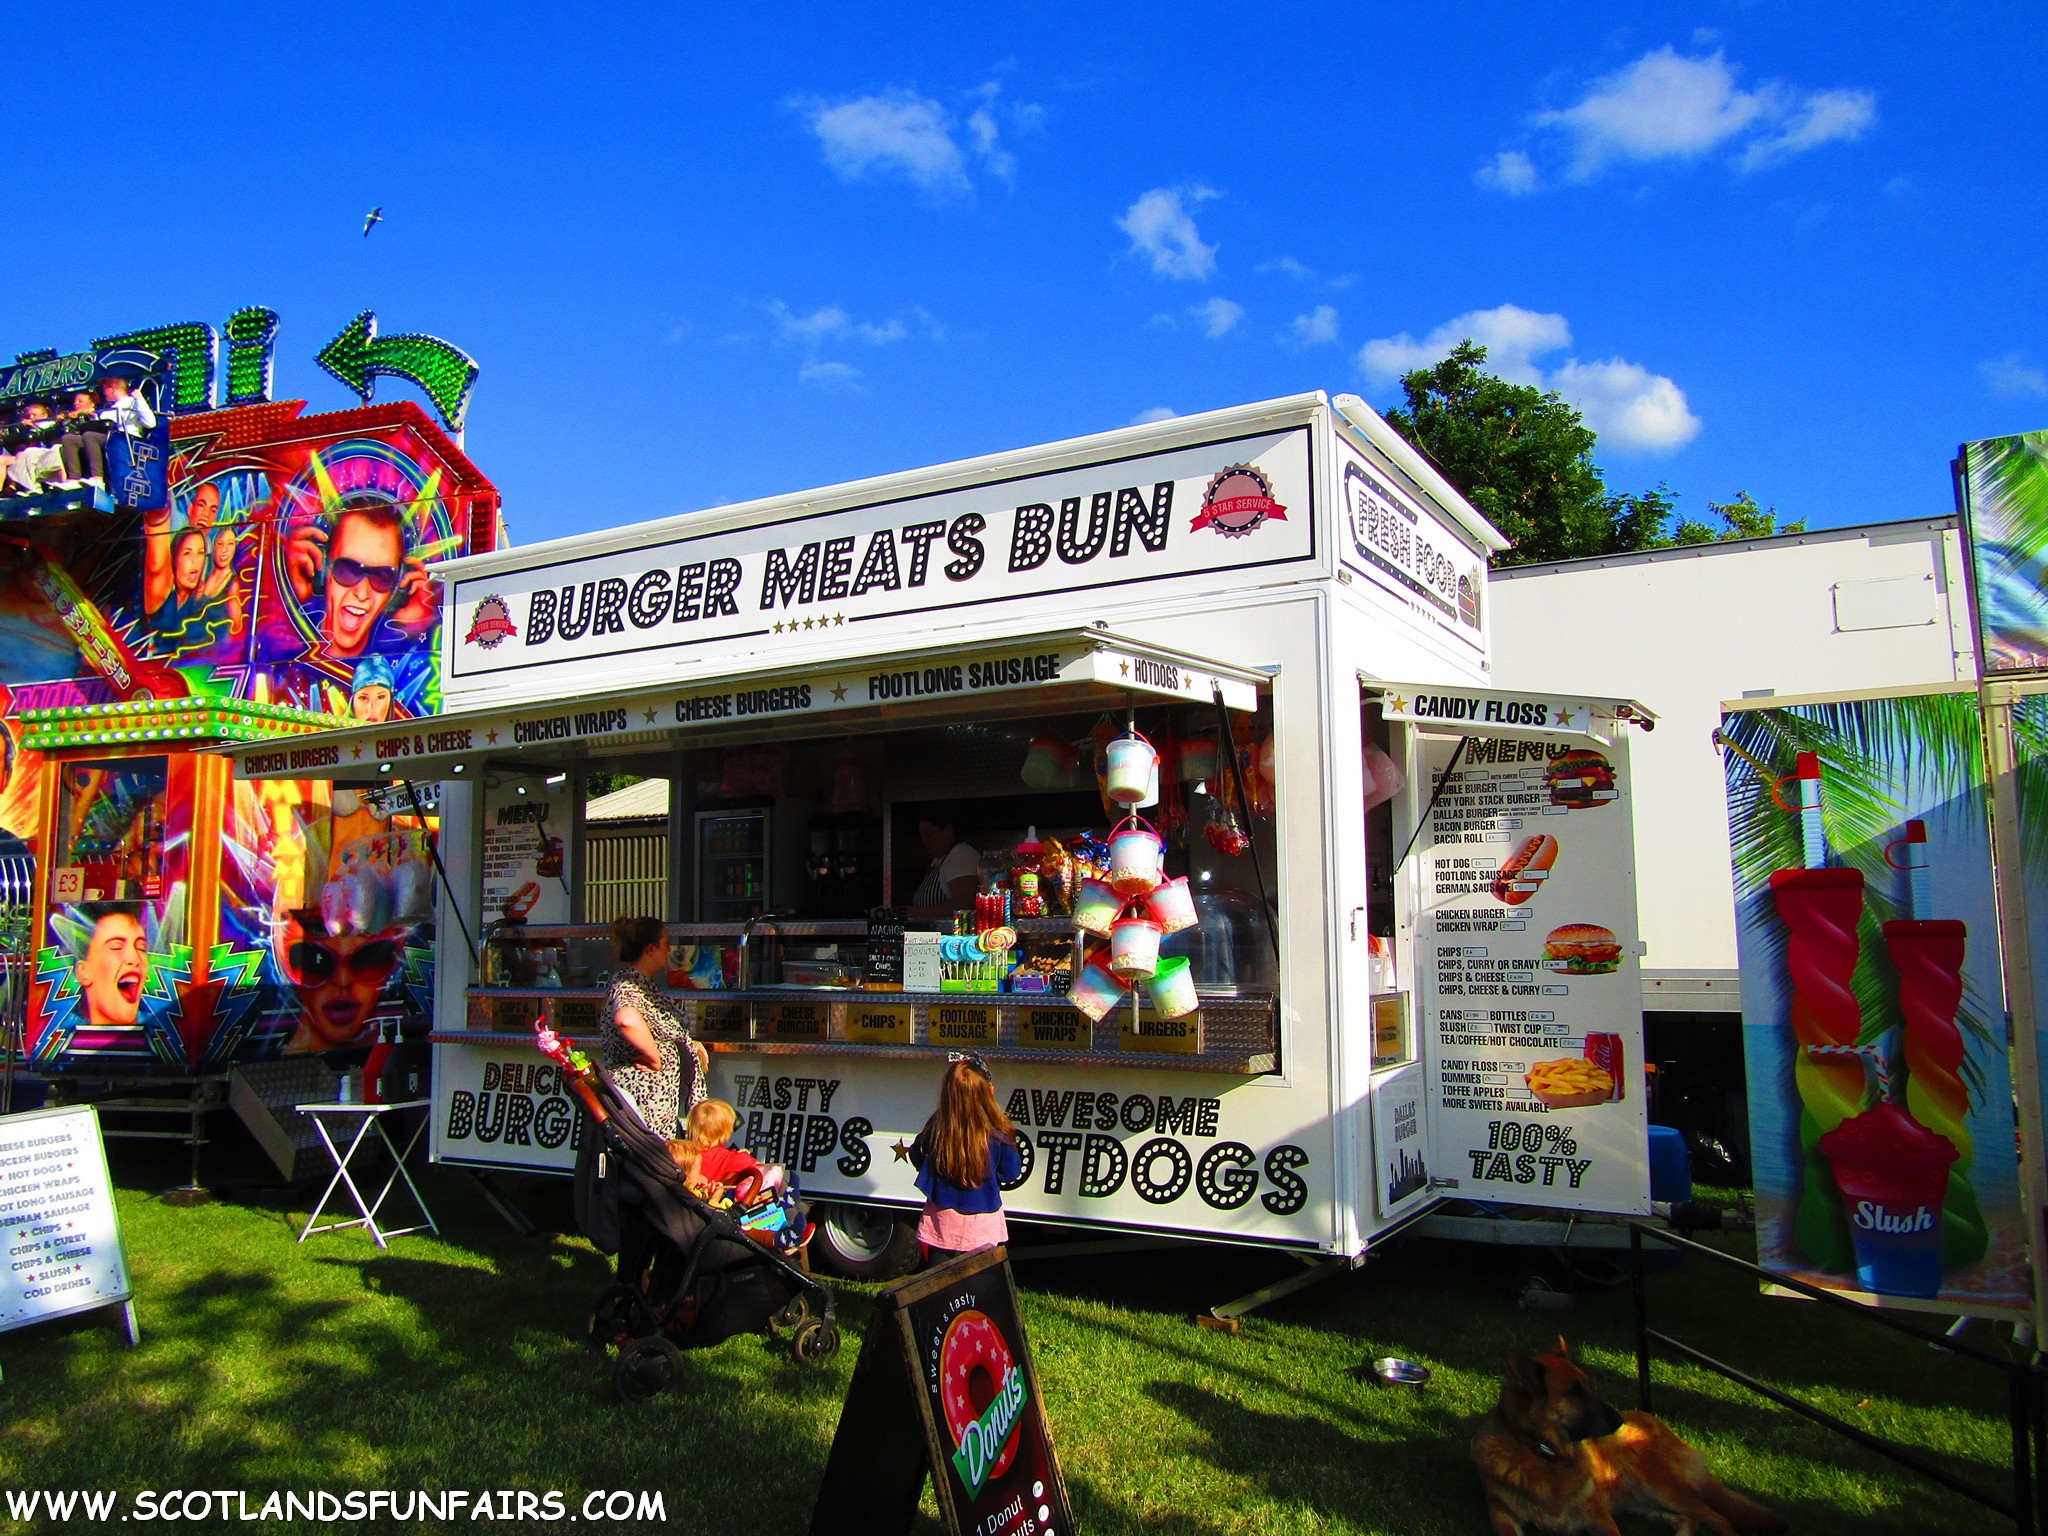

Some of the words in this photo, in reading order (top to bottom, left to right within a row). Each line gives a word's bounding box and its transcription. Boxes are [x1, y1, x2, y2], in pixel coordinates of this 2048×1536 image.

[1203, 508, 1210, 518] 5
[1212, 501, 1234, 515] STAR
[1236, 498, 1272, 510] SERVICE
[1359, 489, 1411, 569] FRESH
[1416, 535, 1457, 600] FOOD
[526, 557, 743, 647] BURGER
[760, 511, 987, 611] MEATS
[1008, 480, 1174, 573] BUN
[868, 664, 963, 701] FOOTLONG
[968, 653, 1061, 688] SAUSAGE
[1134, 658, 1179, 691] HOTDOGS
[675, 690, 732, 722] CHEESE
[736, 684, 811, 716] BURGERS
[1414, 694, 1483, 720] CANDY
[1485, 700, 1548, 726] FLOSS
[514, 716, 571, 743] CHICKEN
[574, 708, 627, 735] WRAPS
[376, 736, 411, 759] CHIPS
[414, 732, 425, 754] &
[428, 729, 473, 752] CHEESE
[1464, 737, 1571, 765] MENU
[245, 751, 288, 774] CHICKEN
[290, 746, 340, 769] BURGERS
[1432, 771, 1464, 783] BUGER
[1465, 783, 1498, 794] BURGER
[1454, 796, 1476, 807] YORK
[1478, 795, 1504, 806] STACK
[1507, 793, 1540, 805] BURGER
[497, 802, 550, 825] MENU
[1433, 811, 1463, 820] DALLAS
[1466, 808, 1498, 818] BURGER
[1434, 823, 1461, 832] BACON
[1463, 820, 1496, 830] BURGER
[1434, 834, 1461, 844] BACON
[1464, 833, 1484, 843] ROLL
[1435, 859, 1450, 869] HOT
[1453, 858, 1470, 868] DOG
[59, 874, 77, 892] £3
[1435, 871, 1476, 881] FOOTLONG
[1480, 869, 1518, 880] SAUSAGE
[1436, 883, 1470, 893] GERMAN
[1473, 882, 1511, 893] SAUSAGE
[1436, 909, 1470, 919] CHICKEN
[1473, 908, 1505, 919] BURGER
[870, 924, 905, 935] NACHOS
[1436, 922, 1470, 932] CHICKEN
[1473, 921, 1498, 931] WRAP
[1437, 947, 1461, 957] CHIPS
[1438, 960, 1465, 971] CHIPS,
[1467, 959, 1495, 969] CURRY
[1498, 959, 1510, 969] OR
[1512, 959, 1540, 969] GRAVY
[1438, 973, 1463, 982] CHIPS
[1465, 973, 1472, 982] &
[1475, 972, 1506, 982] CHEESE
[1439, 985, 1466, 996] CHIPS,
[1468, 985, 1499, 995] CHEESE
[1501, 985, 1509, 995] &
[1511, 985, 1540, 995] CURRY
[563, 1003, 596, 1014] CHICKEN
[705, 1005, 742, 1018] GERMAN
[782, 1006, 816, 1019] CHEESE
[1440, 1010, 1462, 1020] CANS
[1490, 1011, 1526, 1021] BOTTLES
[861, 1014, 896, 1030] CHIPS
[939, 1009, 987, 1026] FOOTLONG
[1030, 1010, 1080, 1028] CHICKEN
[776, 1020, 820, 1034] BURGERS
[939, 1023, 988, 1040] SAUSAGE
[1033, 1025, 1076, 1042] WRAPS
[1131, 1021, 1187, 1037] URGERS
[1440, 1022, 1466, 1032] SLUSH
[1494, 1023, 1523, 1034] TWIST
[1524, 1024, 1541, 1034] CUP
[1440, 1034, 1506, 1047] TEA/COFFEE/HOT
[1510, 1036, 1558, 1048] CHOCOLATE
[1441, 1060, 1468, 1071] CANDY
[1472, 1061, 1498, 1071] FLOSS
[483, 1062, 571, 1097] DELICI
[1442, 1073, 1481, 1084] DUMMIES
[734, 1074, 841, 1113] TASTY
[1442, 1085, 1470, 1097] TOFFEE
[1473, 1087, 1505, 1098] APPLES
[1005, 1088, 1220, 1138] AWESOME
[1394, 1100, 1416, 1125] DALLAS
[1442, 1098, 1466, 1109] MORE
[1469, 1099, 1503, 1111] SWEETS
[1505, 1101, 1550, 1113] AVAILABLE
[447, 1090, 583, 1151] BURG
[28, 1133, 73, 1148] BURGERS
[1488, 1120, 1577, 1156] 100%
[34, 1147, 79, 1161] BURGERS
[8, 1170, 30, 1180] HOT
[33, 1164, 63, 1176] DOGS
[997, 1128, 1310, 1217] OTDOGS
[1468, 1149, 1592, 1189] TASTY
[43, 1175, 80, 1189] WRAPS
[17, 1196, 46, 1209] LONG
[49, 1187, 95, 1203] SAUSAGE
[44, 1202, 91, 1219] SAUSAGE
[1853, 1200, 1935, 1234] Slush
[31, 1223, 62, 1236] CHIPS
[9, 1242, 41, 1257] CHIPS
[53, 1232, 87, 1248] CURRY
[11, 1256, 42, 1272] CHIPS
[55, 1246, 92, 1262] CHEESE
[38, 1266, 71, 1281] SLUSH
[23, 1286, 52, 1300] COLD
[54, 1277, 92, 1294] DRINKS
[930, 1326, 943, 1394] sweet
[950, 1292, 976, 1313] tasty
[960, 1363, 1023, 1487] Donuts
[987, 1494, 1024, 1534] Donut
